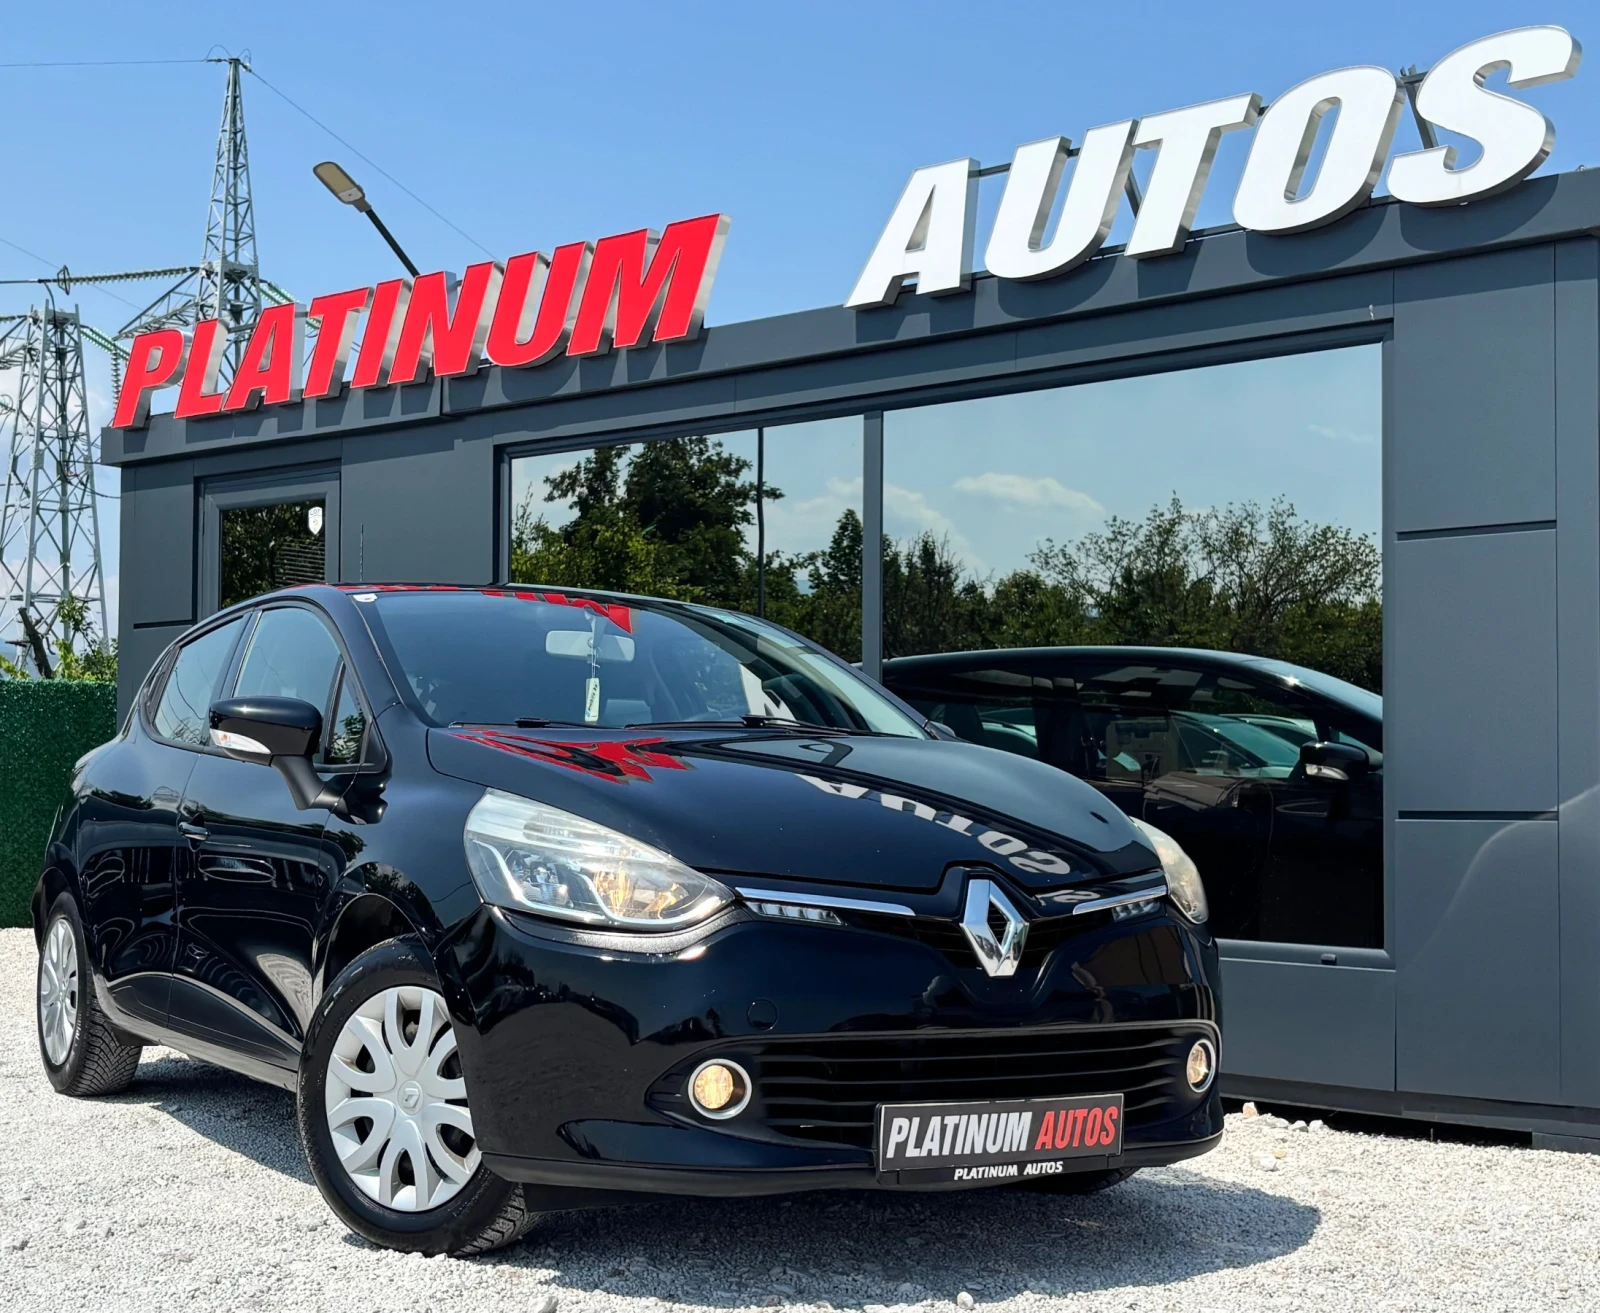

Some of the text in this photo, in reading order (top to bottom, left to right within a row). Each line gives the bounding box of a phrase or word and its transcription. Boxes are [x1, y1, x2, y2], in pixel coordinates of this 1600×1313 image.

[112, 24, 1580, 429] PLATINUM AUTOS
[886, 1106, 1118, 1158] PLATINUM AUTOS
[953, 1161, 1064, 1181] PLATINUM AUTOS
